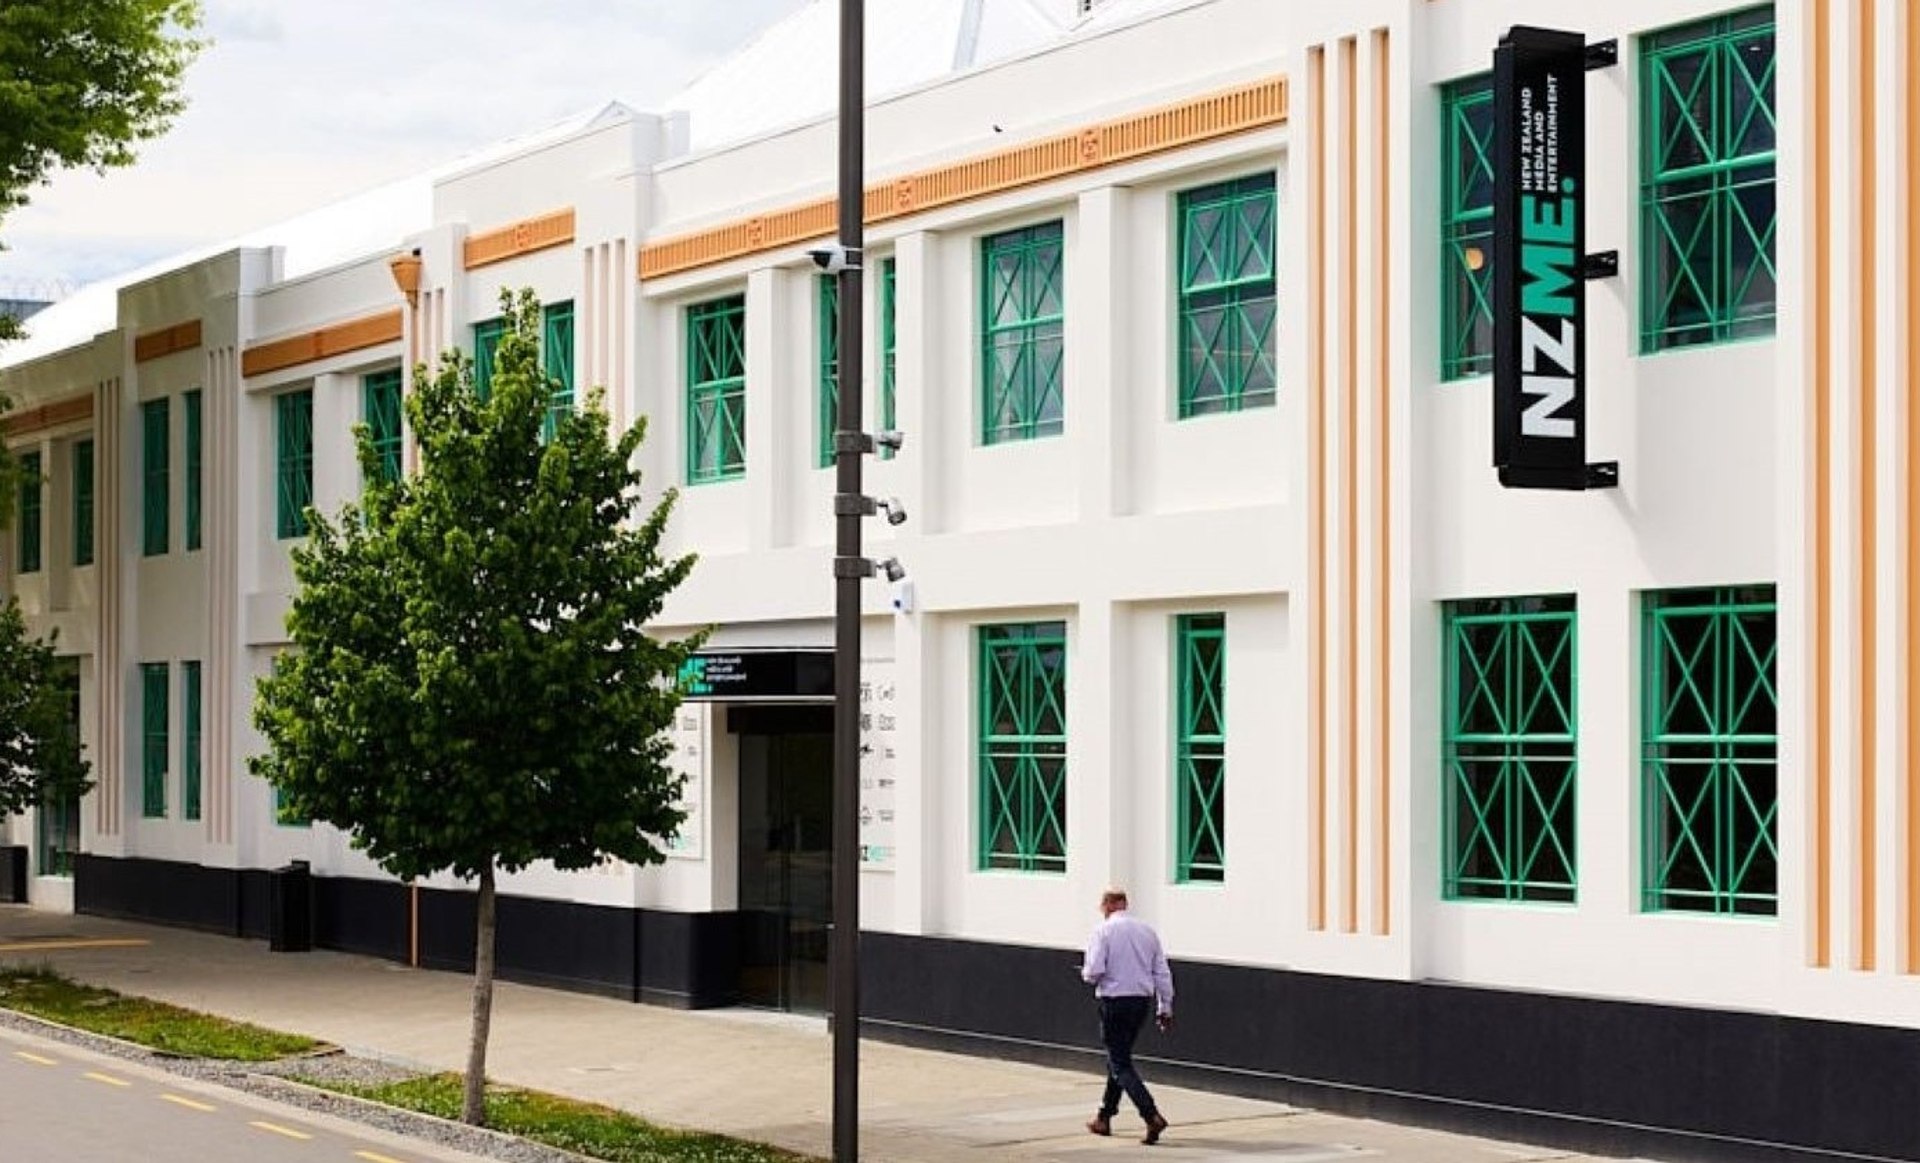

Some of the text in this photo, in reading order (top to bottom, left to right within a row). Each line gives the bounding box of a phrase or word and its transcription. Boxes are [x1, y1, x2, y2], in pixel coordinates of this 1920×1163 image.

[1521, 87, 1532, 191] NEW ZEALAND
[1534, 111, 1545, 191] MEDIA AND
[1547, 74, 1558, 193] ENTERTAINMENT
[1522, 177, 1575, 438] NZME.
